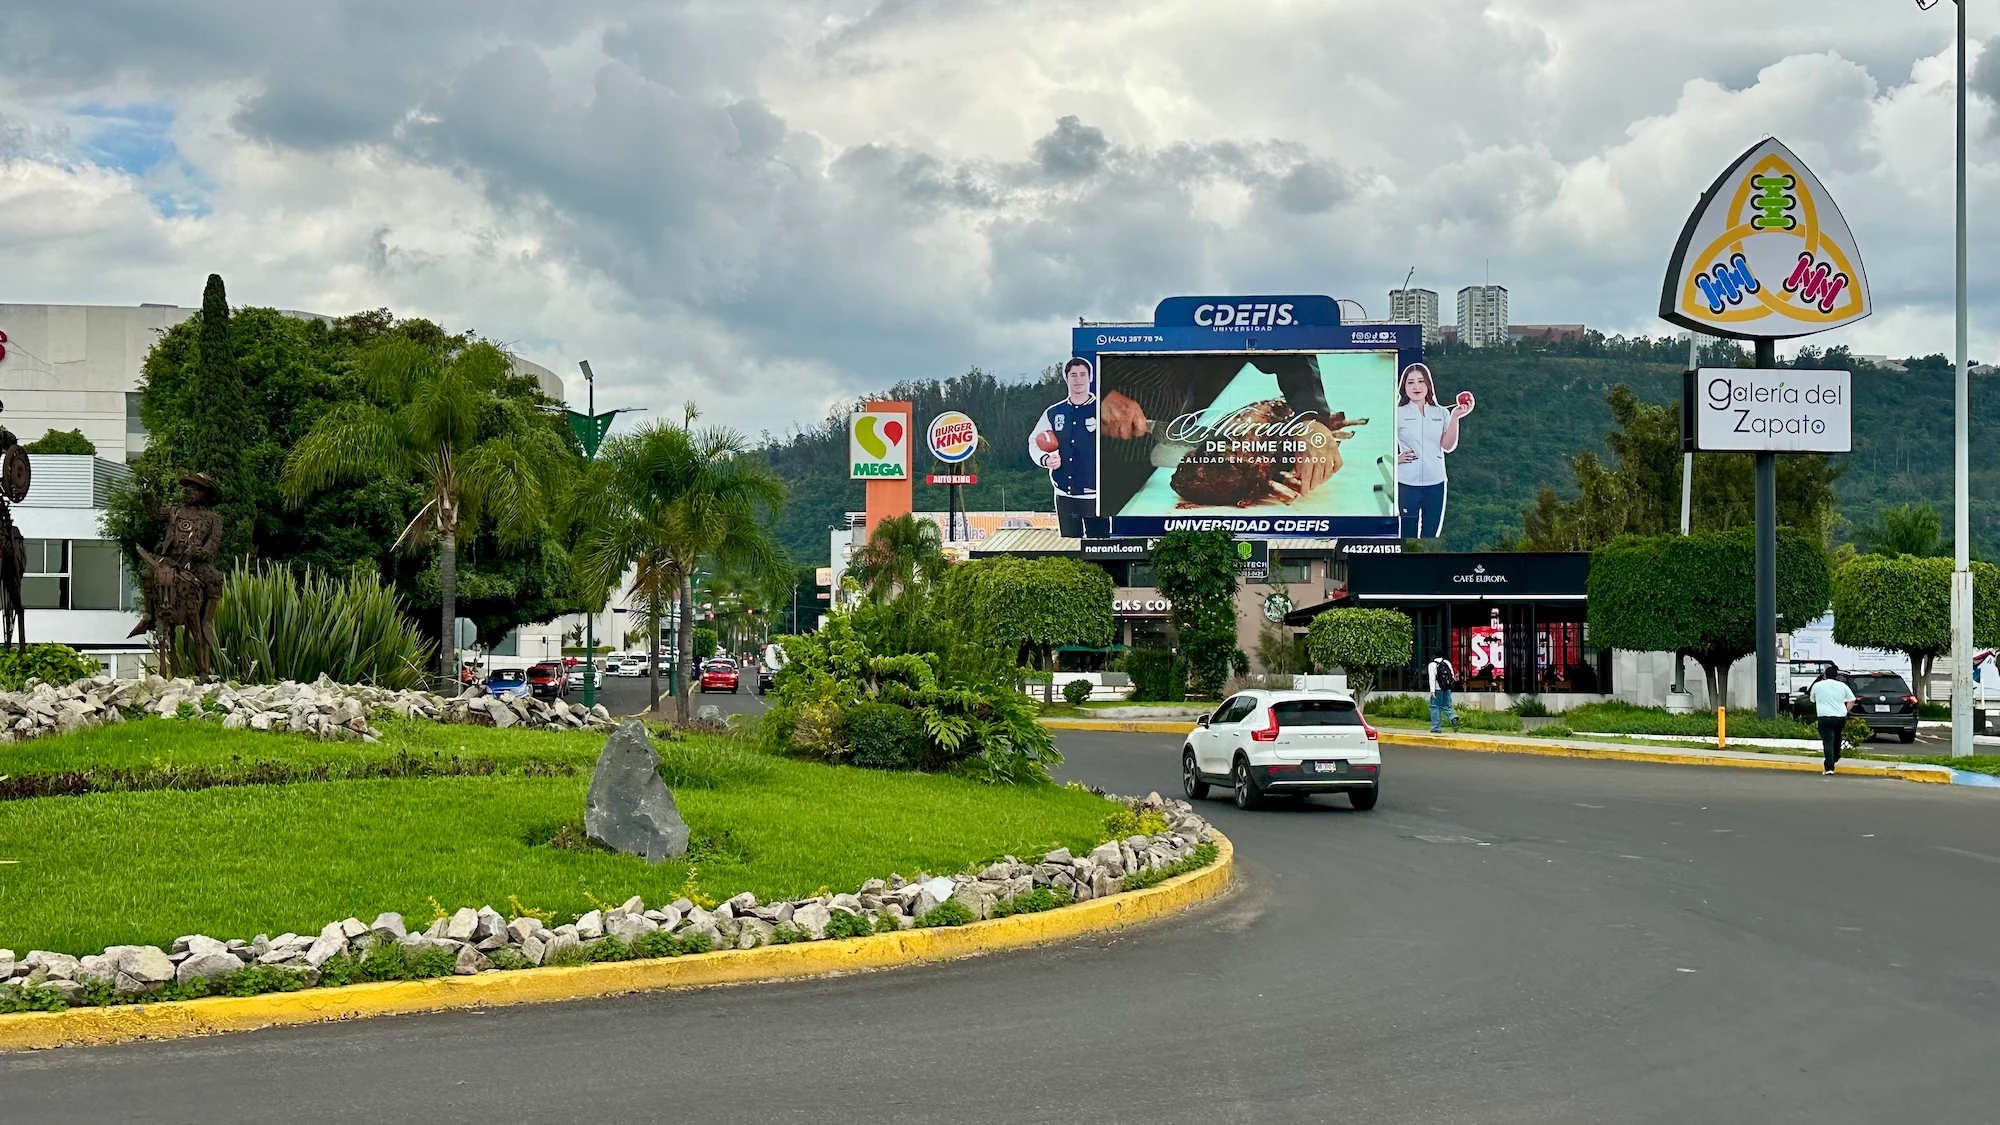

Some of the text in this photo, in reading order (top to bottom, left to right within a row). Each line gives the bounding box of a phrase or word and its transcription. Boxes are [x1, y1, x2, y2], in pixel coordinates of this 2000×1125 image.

[1805, 384, 1842, 405] del
[935, 422, 972, 438] BURGER
[1733, 409, 1826, 438] Zapato
[936, 430, 973, 449] KING
[1206, 440, 1226, 453] DE
[1231, 440, 1277, 453] PRIME
[1283, 440, 1307, 453] RIB
[1178, 456, 1327, 465] CALIDAD EN CADA BOCADO
[853, 462, 905, 477] MEGA
[933, 474, 971, 484] AUTO KING
[1164, 519, 1330, 533] UNIVERSIDAD CDEFIS
[1085, 544, 1143, 553] naranti.com
[1342, 544, 1402, 554] 4432741515
[1453, 573, 1508, 583] CAFÉ EUROPA
